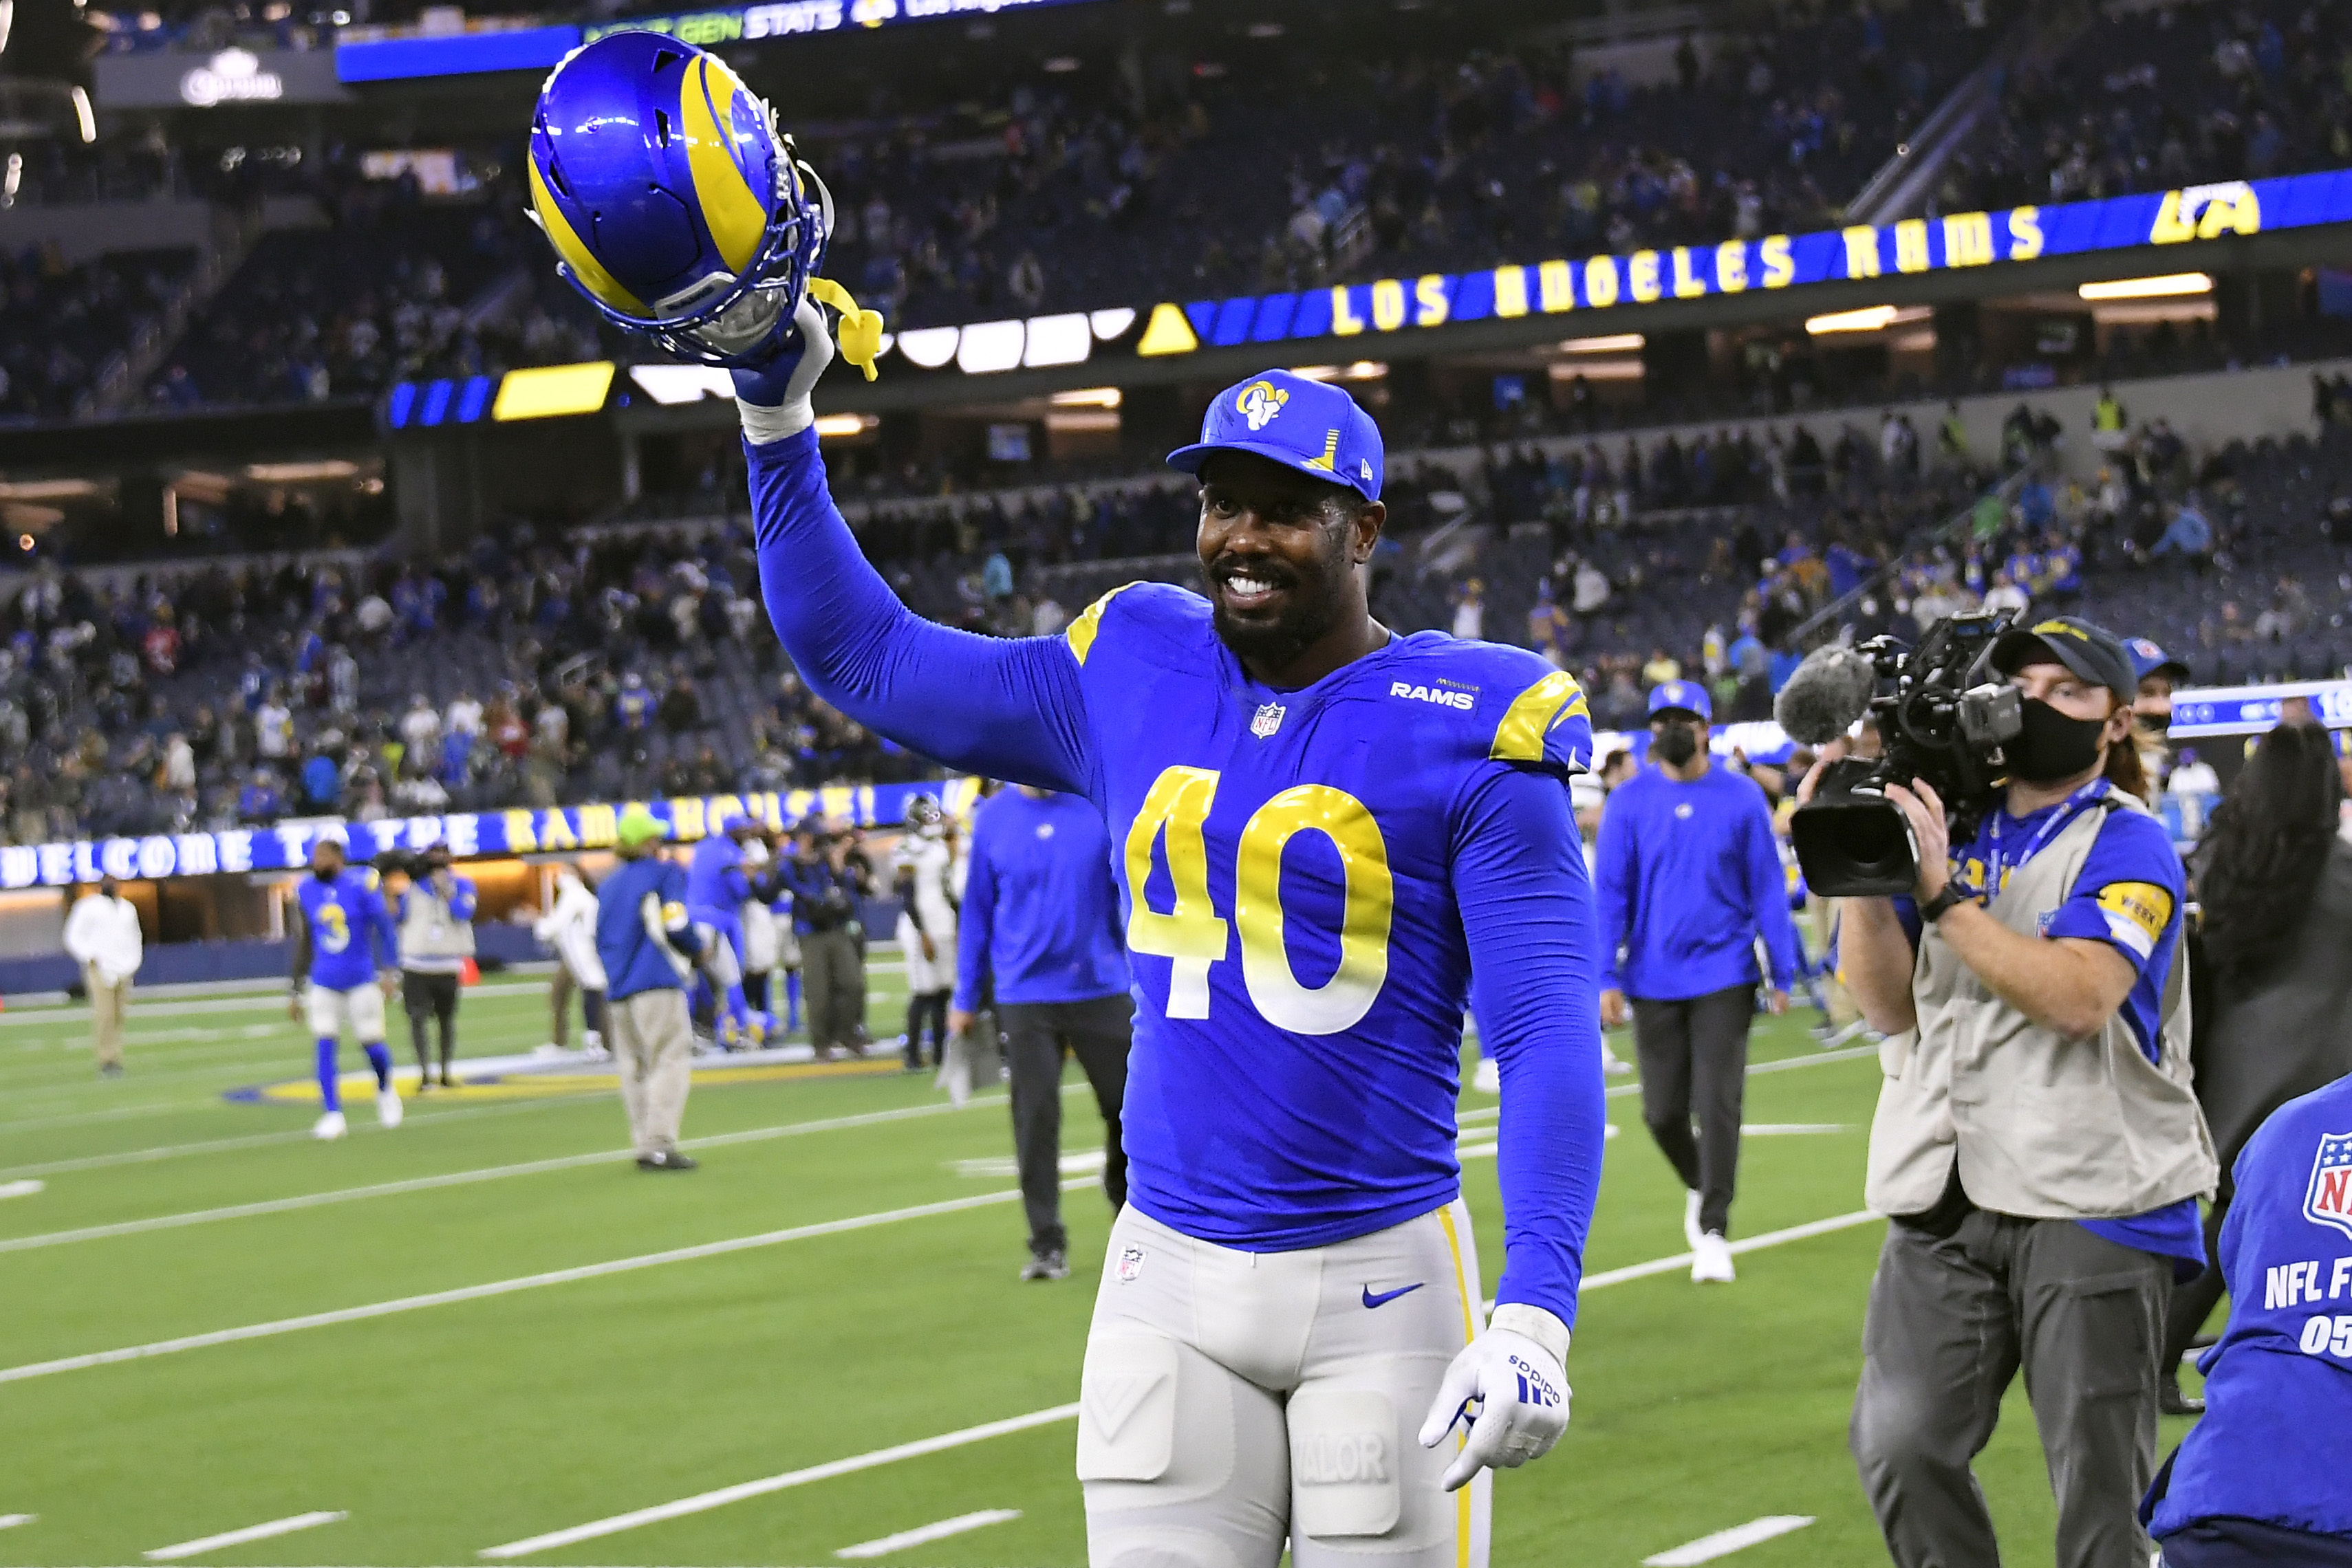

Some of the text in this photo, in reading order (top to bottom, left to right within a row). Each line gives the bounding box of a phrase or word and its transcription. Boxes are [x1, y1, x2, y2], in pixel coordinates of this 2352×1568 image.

[743, 0, 843, 40] STATS
[1332, 274, 1449, 336] LOS
[1390, 682, 1474, 710] RAMS
[1255, 716, 1277, 732] NFL
[0, 829, 254, 889] WELCOME
[1125, 765, 1394, 1035] 40
[319, 902, 350, 955] 3
[2265, 1261, 2322, 1311] NFL
[1509, 1354, 1561, 1404] adidas
